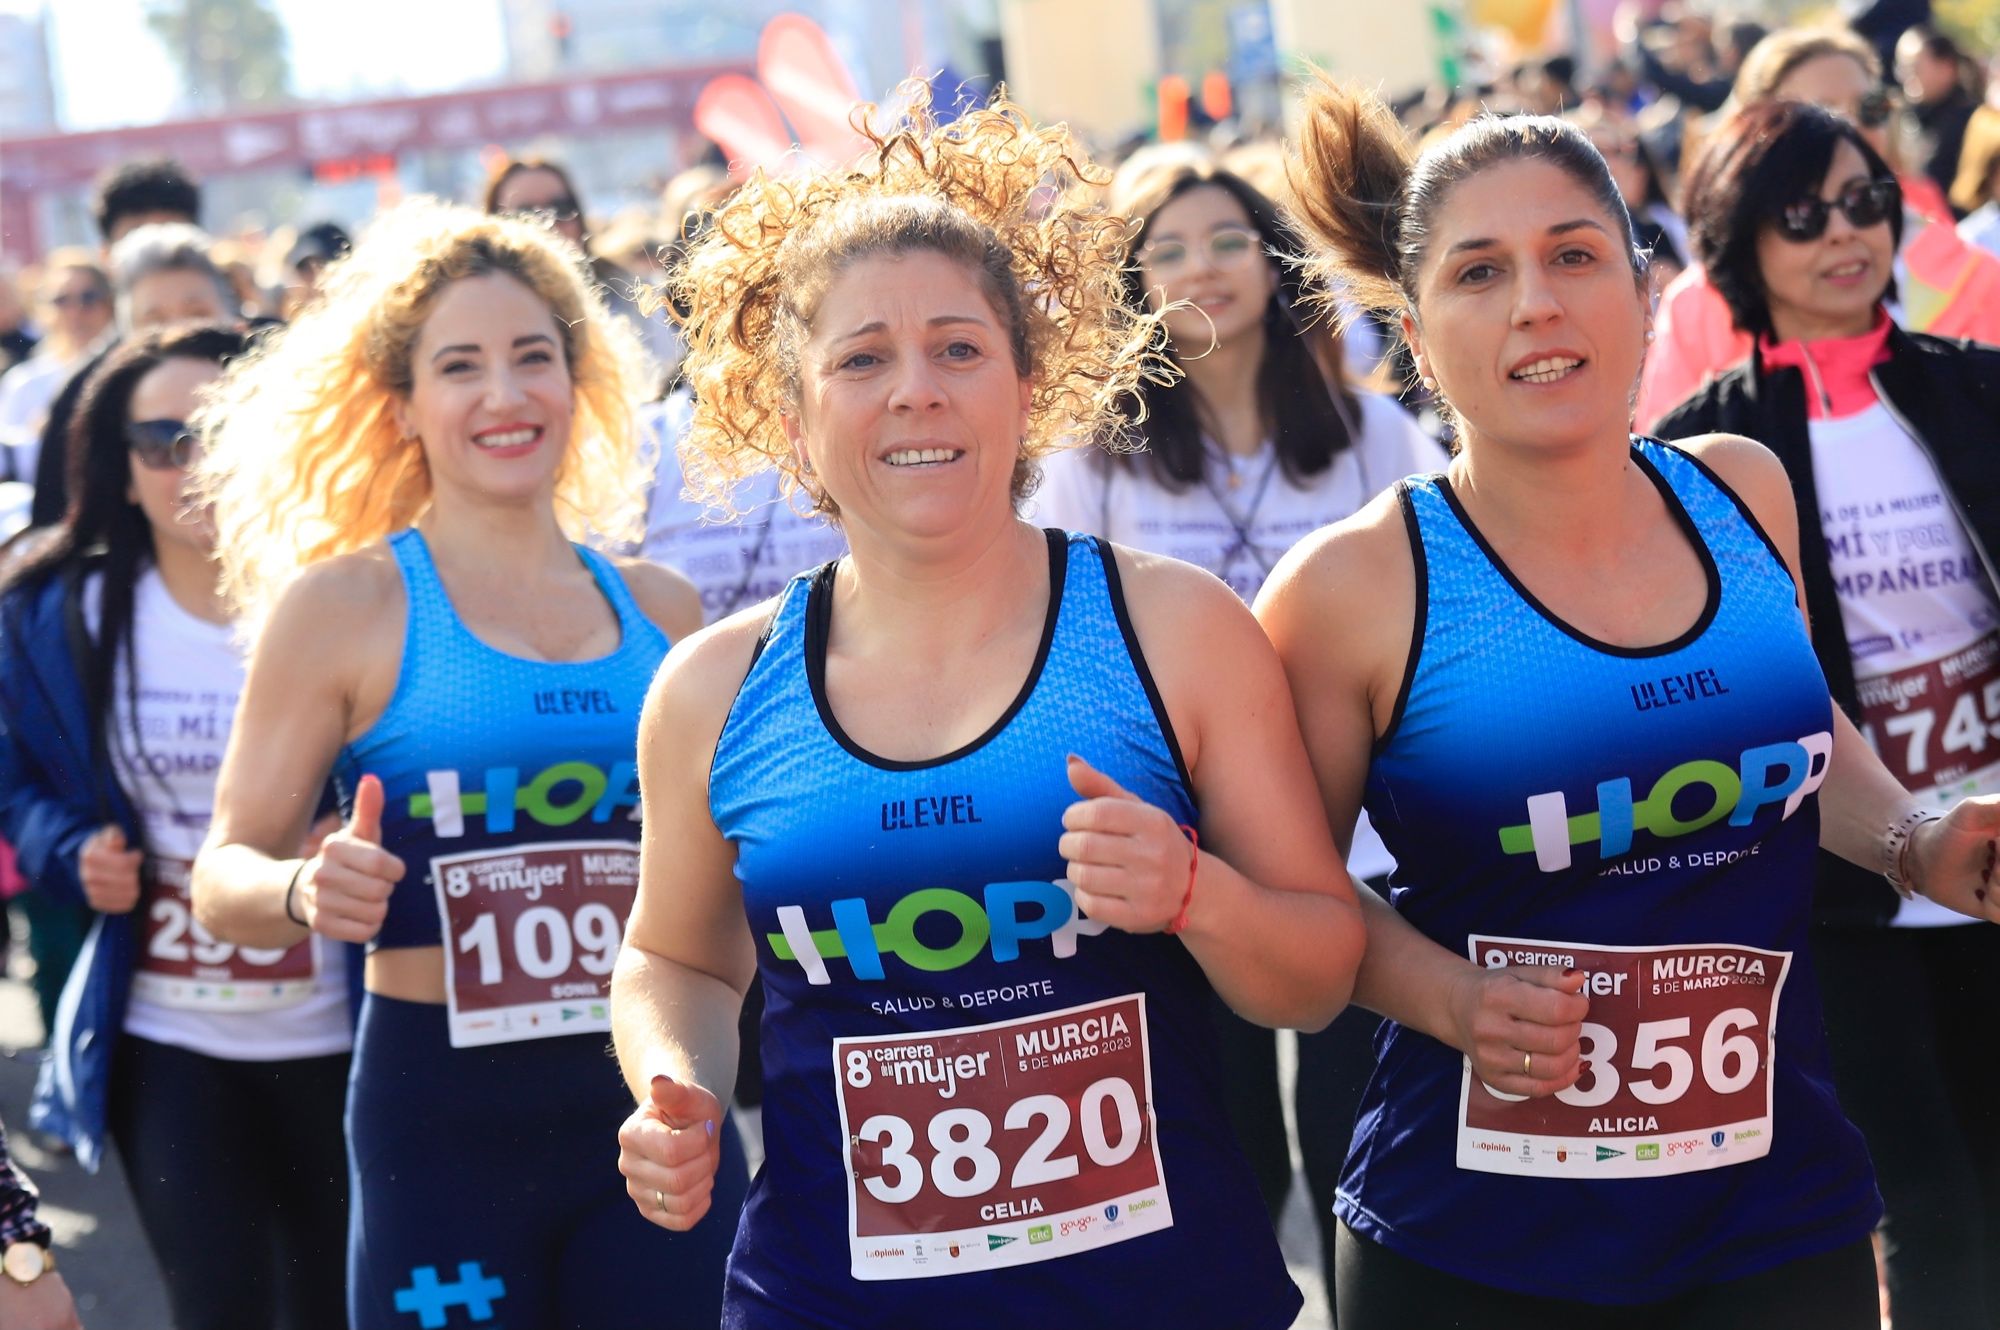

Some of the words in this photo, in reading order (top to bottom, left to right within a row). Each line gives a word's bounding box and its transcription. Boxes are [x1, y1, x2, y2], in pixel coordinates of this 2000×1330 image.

[533, 690, 619, 715] ULEVEL
[1630, 668, 1730, 712] ULEVEL
[409, 761, 642, 838] HOP
[881, 794, 982, 832] ULEVEL
[1498, 731, 1833, 873] HOPP
[1668, 855, 1681, 869] &
[488, 864, 567, 900] mujer
[459, 902, 627, 986] 109
[1515, 951, 1574, 970] carrera
[1652, 955, 1765, 980] MURCIA
[1652, 984, 1661, 995] 5
[1664, 981, 1680, 993] DE
[1683, 975, 1729, 991] MARZO
[871, 996, 937, 1015] SALUD
[942, 996, 954, 1009] &
[959, 979, 1054, 1009] DEPORTE
[1015, 1012, 1129, 1057] MURCIA
[874, 1044, 934, 1062] carrera
[1019, 1060, 1028, 1072] 5
[1031, 1056, 1049, 1070] DE
[1052, 1044, 1099, 1066] MARZO
[1101, 1036, 1132, 1054] 2023
[1480, 1007, 1760, 1107] 856
[894, 1051, 991, 1099] mujer
[858, 1076, 1142, 1204] 3820
[1588, 1116, 1659, 1133] ALICIA
[980, 1197, 1044, 1221] CELIA
